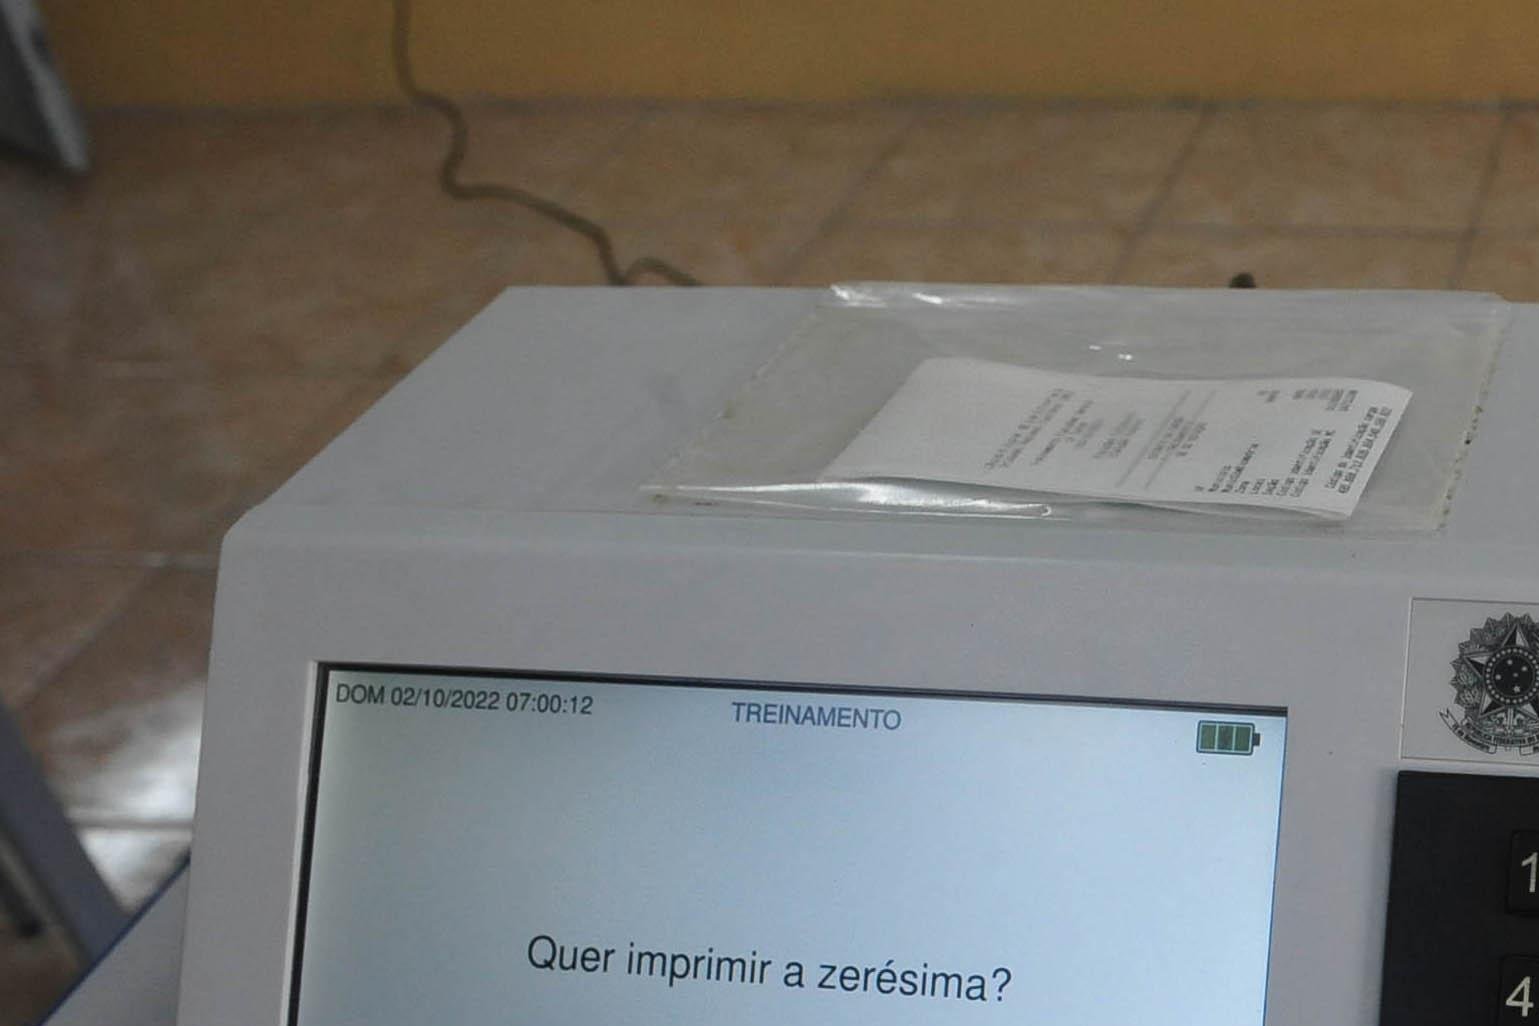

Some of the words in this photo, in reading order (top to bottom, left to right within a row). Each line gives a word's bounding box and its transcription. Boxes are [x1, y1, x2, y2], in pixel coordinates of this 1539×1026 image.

[336, 683, 385, 704] DOM
[390, 686, 500, 710] 02/10/2022
[506, 691, 593, 715] 07:00:12
[731, 701, 902, 731] TREINAMENTO
[1521, 852, 1538, 893] 1
[527, 935, 616, 974] Quer
[627, 942, 772, 988] imprimir
[783, 961, 805, 988] a
[817, 960, 1013, 1002] zerésima?
[1505, 976, 1534, 1017] 4
